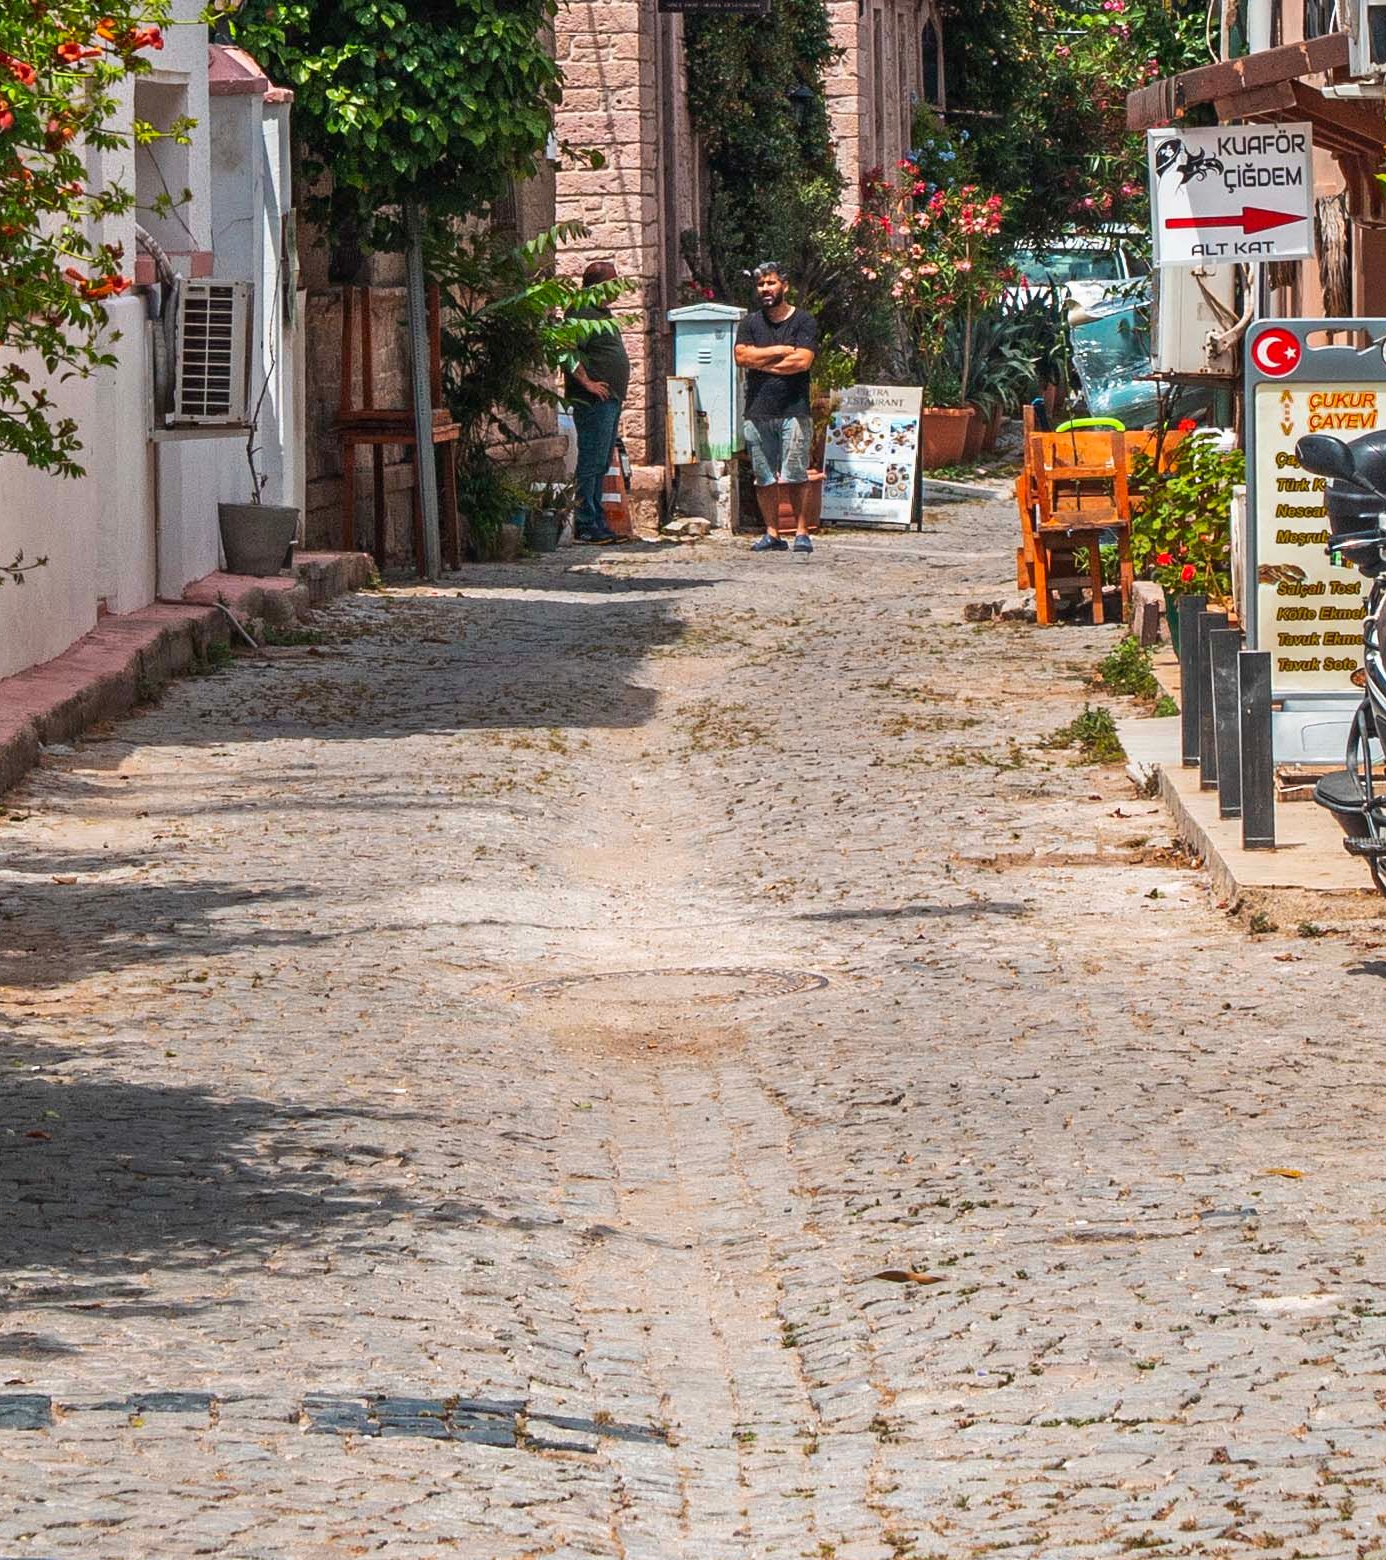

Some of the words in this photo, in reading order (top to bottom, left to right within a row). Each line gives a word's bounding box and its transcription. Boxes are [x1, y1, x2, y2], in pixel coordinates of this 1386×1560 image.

[1218, 130, 1305, 155] KUAFÖR
[1224, 163, 1302, 193] ÇİĞDEM
[1191, 243, 1228, 256] ALT
[1235, 241, 1274, 254] KAT
[843, 396, 905, 408] ESTAURANT
[1309, 393, 1376, 409] ÇUKUR
[1309, 409, 1378, 431] ÇAYEVİ
[1277, 478, 1310, 492] Türk
[1277, 581, 1325, 597] Salçalı
[1329, 581, 1361, 595] Tost
[1276, 607, 1316, 621] Köfte
[1278, 632, 1320, 647] Tavuk
[1323, 632, 1365, 646] Ekme
[1278, 657, 1320, 672] Tavuk
[1323, 657, 1357, 671] Sote
